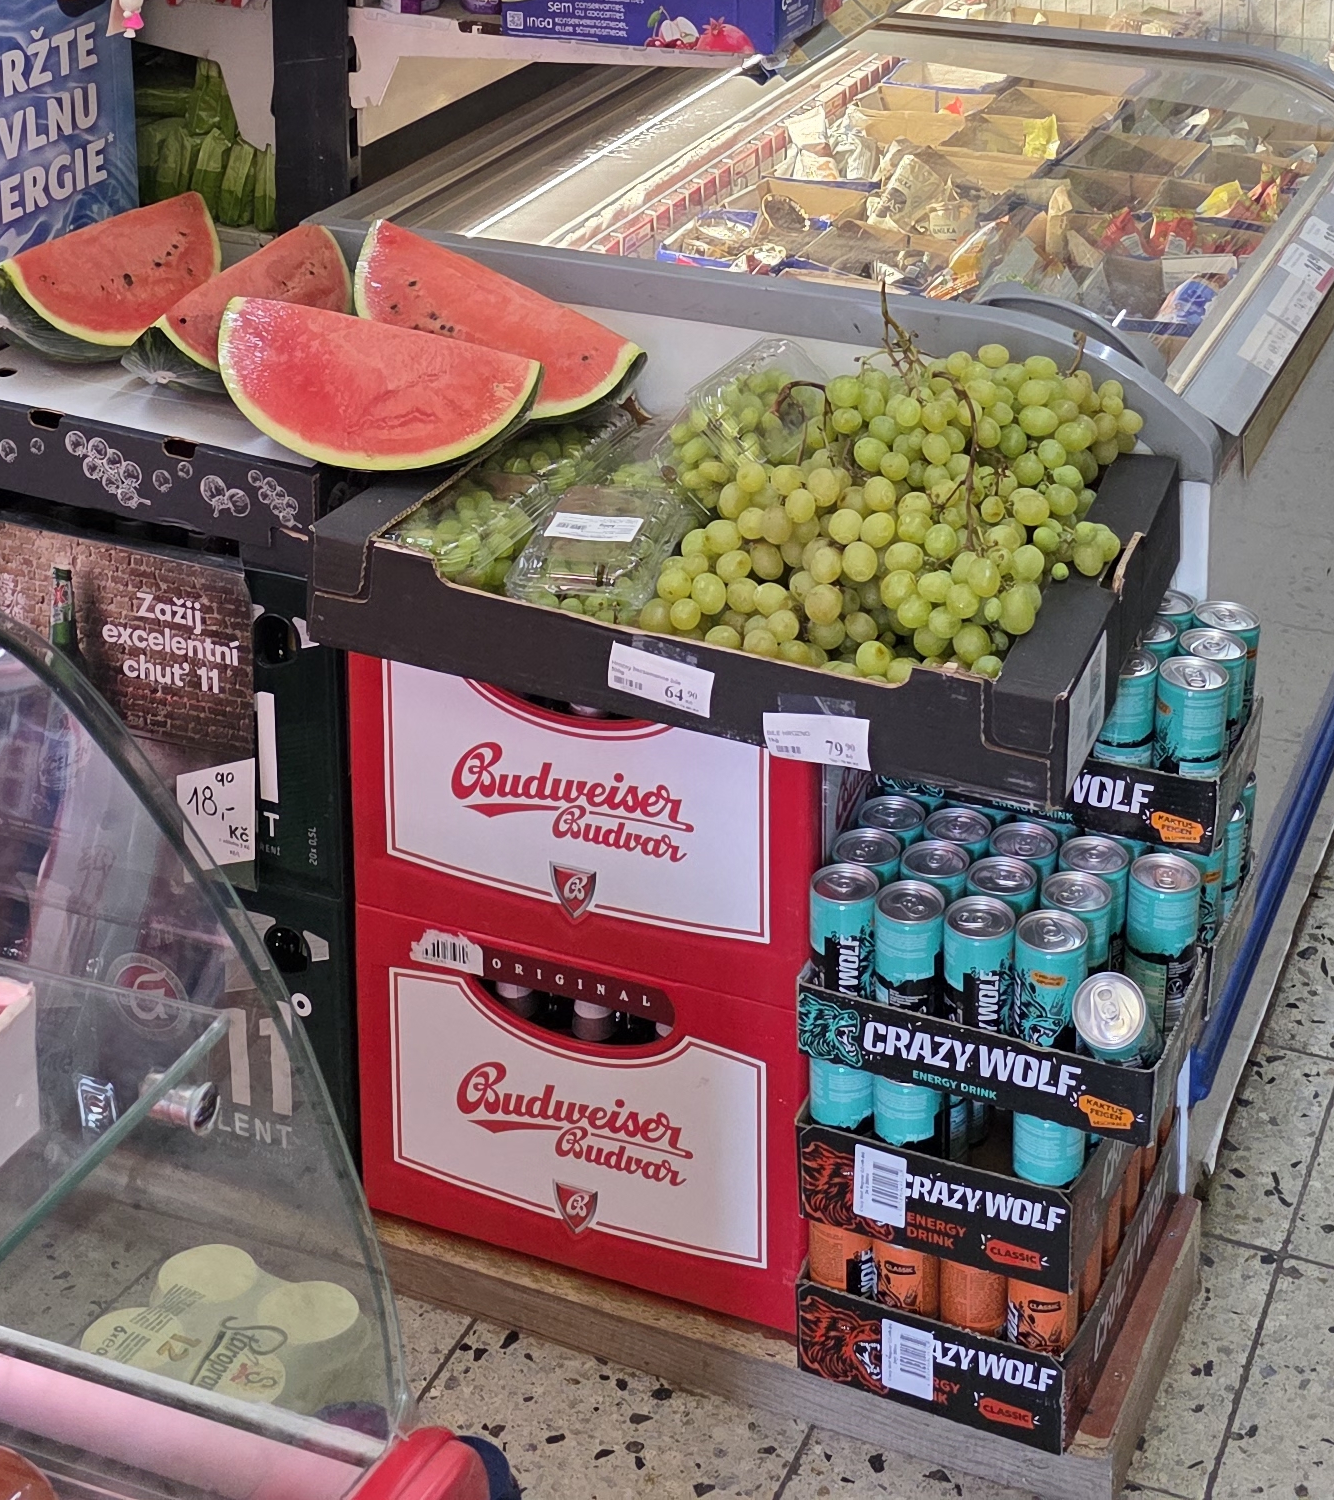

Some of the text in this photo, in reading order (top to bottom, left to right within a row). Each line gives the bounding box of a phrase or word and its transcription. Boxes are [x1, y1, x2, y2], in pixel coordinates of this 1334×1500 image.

[136, 592, 202, 635] Zažij
[102, 623, 240, 667] excelentní
[122, 655, 220, 694] chuť 11
[664, 685, 698, 703] 64 90
[825, 740, 856, 756] 79 90
[215, 771, 234, 786] 90
[451, 741, 694, 833] Budweiser
[229, 825, 249, 843] Kč
[552, 805, 687, 863] Budvar
[839, 933, 860, 981] WOLF
[491, 957, 651, 1007] ORIGINAL
[979, 969, 1000, 1020] WOLF
[864, 1022, 1081, 1097] CRAZY WOLF
[912, 1069, 998, 1101] ENERGY DRINK
[456, 1061, 694, 1160] Budweiser
[555, 1126, 687, 1187] Budvar
[907, 1212, 966, 1238] ENERGY
[986, 1192, 1065, 1231] WOLF
[907, 1227, 955, 1248] DRINK
[990, 1245, 1037, 1265] CLASSIC
[886, 1263, 916, 1275] CLASSIC
[1029, 1301, 1061, 1313] CLASSIC
[978, 1351, 1056, 1391] WOLF
[982, 1403, 1030, 1424] CLASSIC
